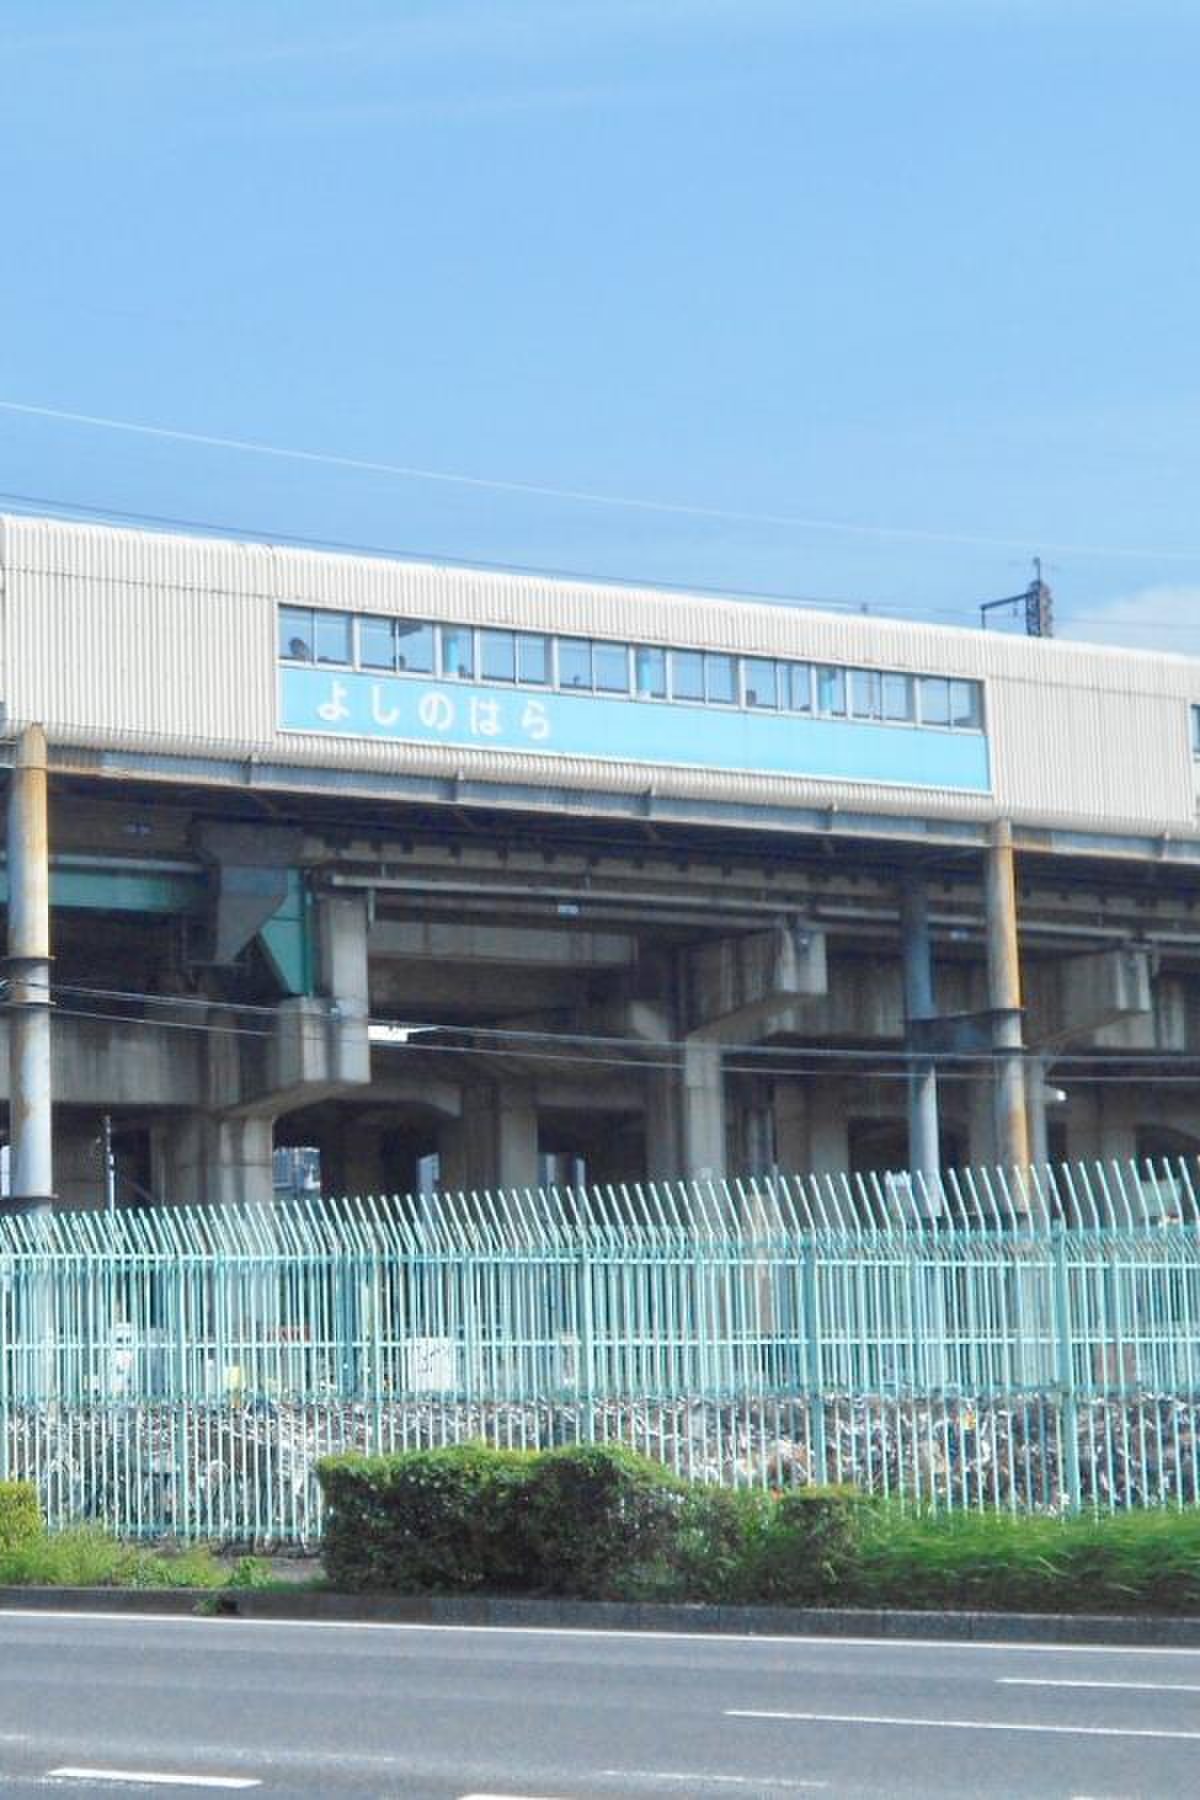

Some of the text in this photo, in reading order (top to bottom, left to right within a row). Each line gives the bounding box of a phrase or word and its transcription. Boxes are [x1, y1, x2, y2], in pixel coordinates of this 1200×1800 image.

[318, 680, 549, 738] よしのはら
